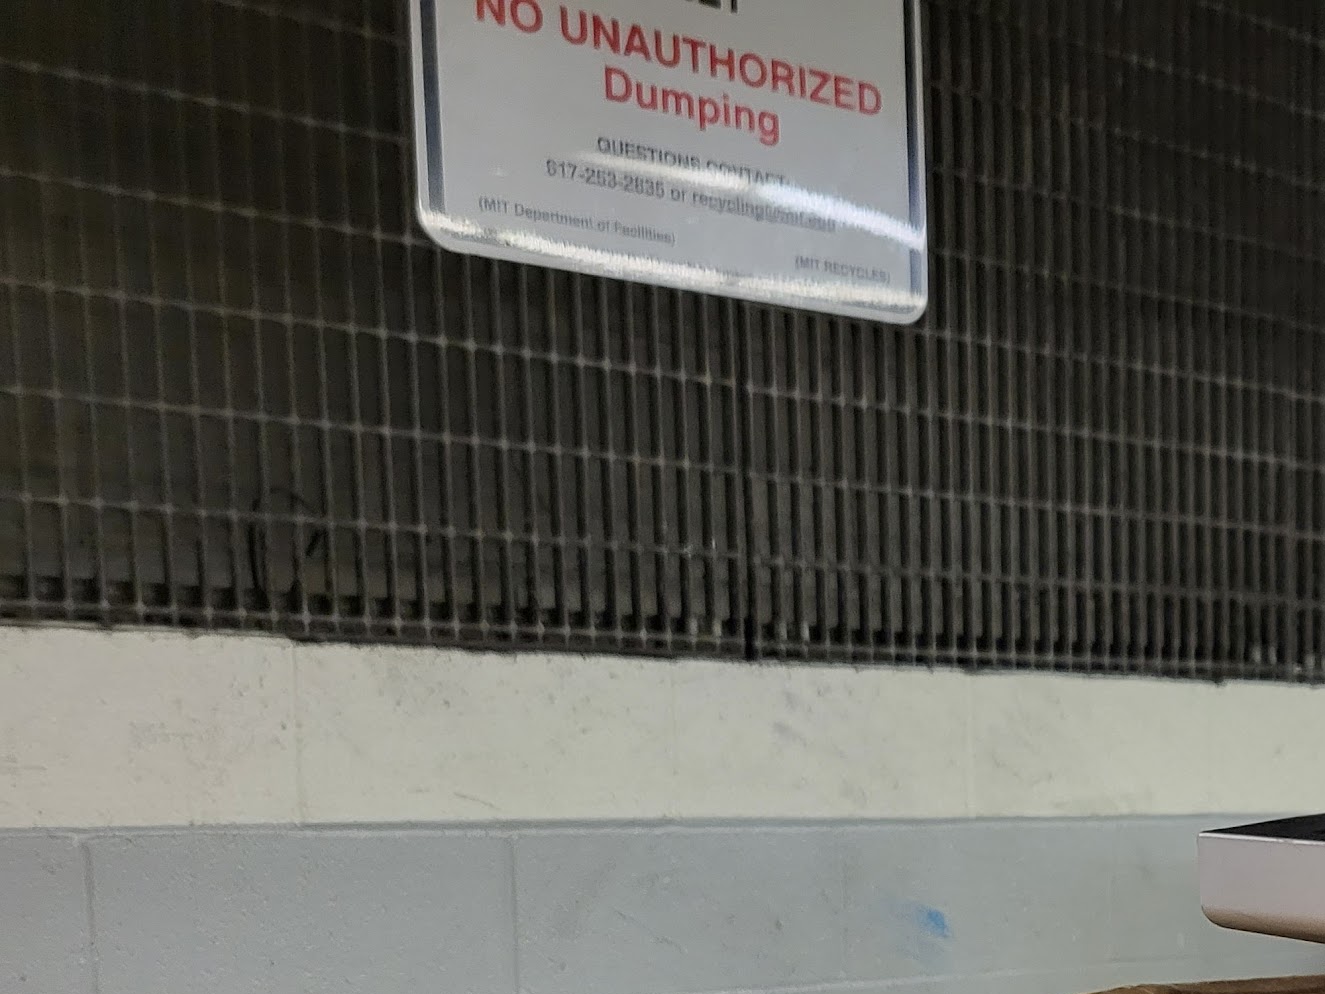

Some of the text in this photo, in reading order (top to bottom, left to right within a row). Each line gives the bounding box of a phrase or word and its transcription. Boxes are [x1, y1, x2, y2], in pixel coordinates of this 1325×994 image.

[476, 0, 883, 115] NO UNAUTHORIZED
[604, 64, 781, 146] Dumping
[514, 202, 593, 230] Department
[597, 221, 611, 233] of
[671, 188, 686, 203] or
